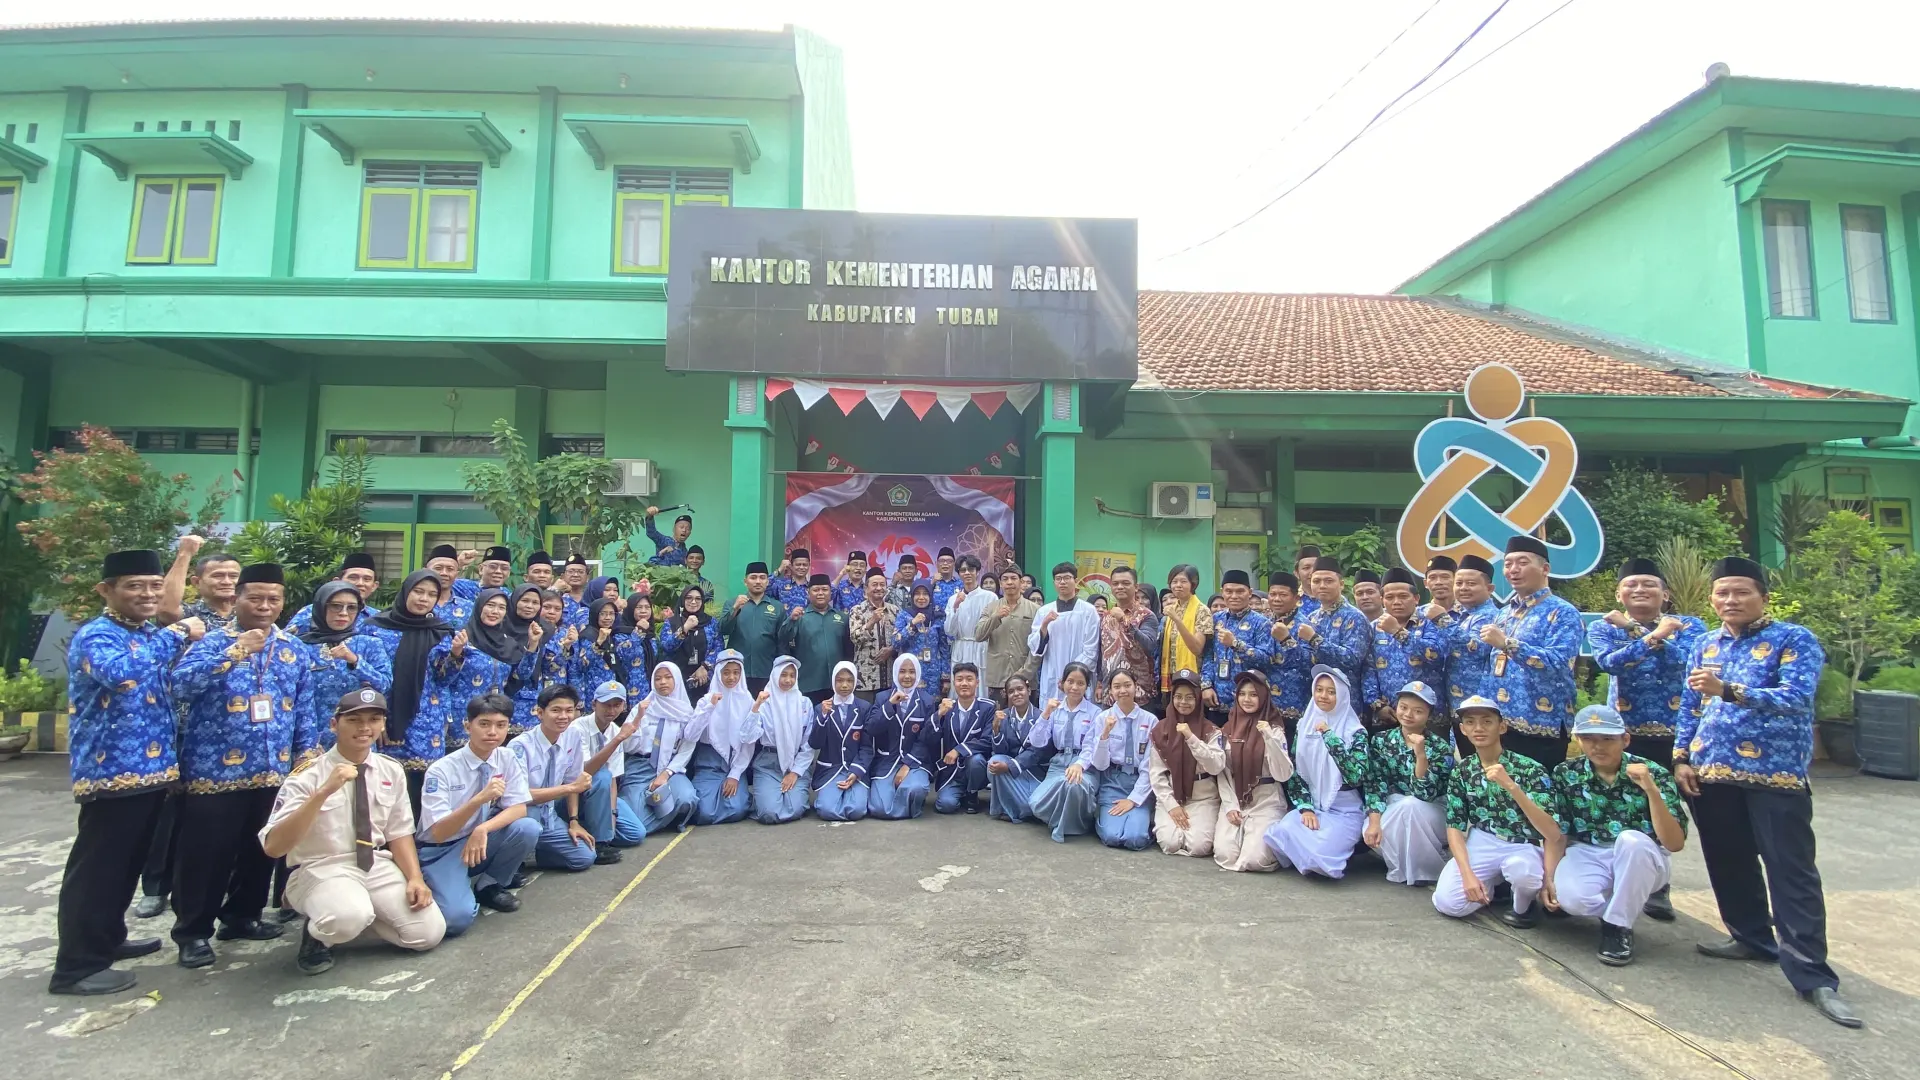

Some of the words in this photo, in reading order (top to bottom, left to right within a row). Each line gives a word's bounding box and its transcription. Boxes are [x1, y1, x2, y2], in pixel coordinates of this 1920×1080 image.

[710, 257, 811, 285] KANTOR
[826, 260, 993, 290] KEMENTERIAN
[1010, 265, 1098, 292] AGAMA
[807, 303, 916, 325] KABUPATEN
[936, 307, 999, 327] TUBAN
